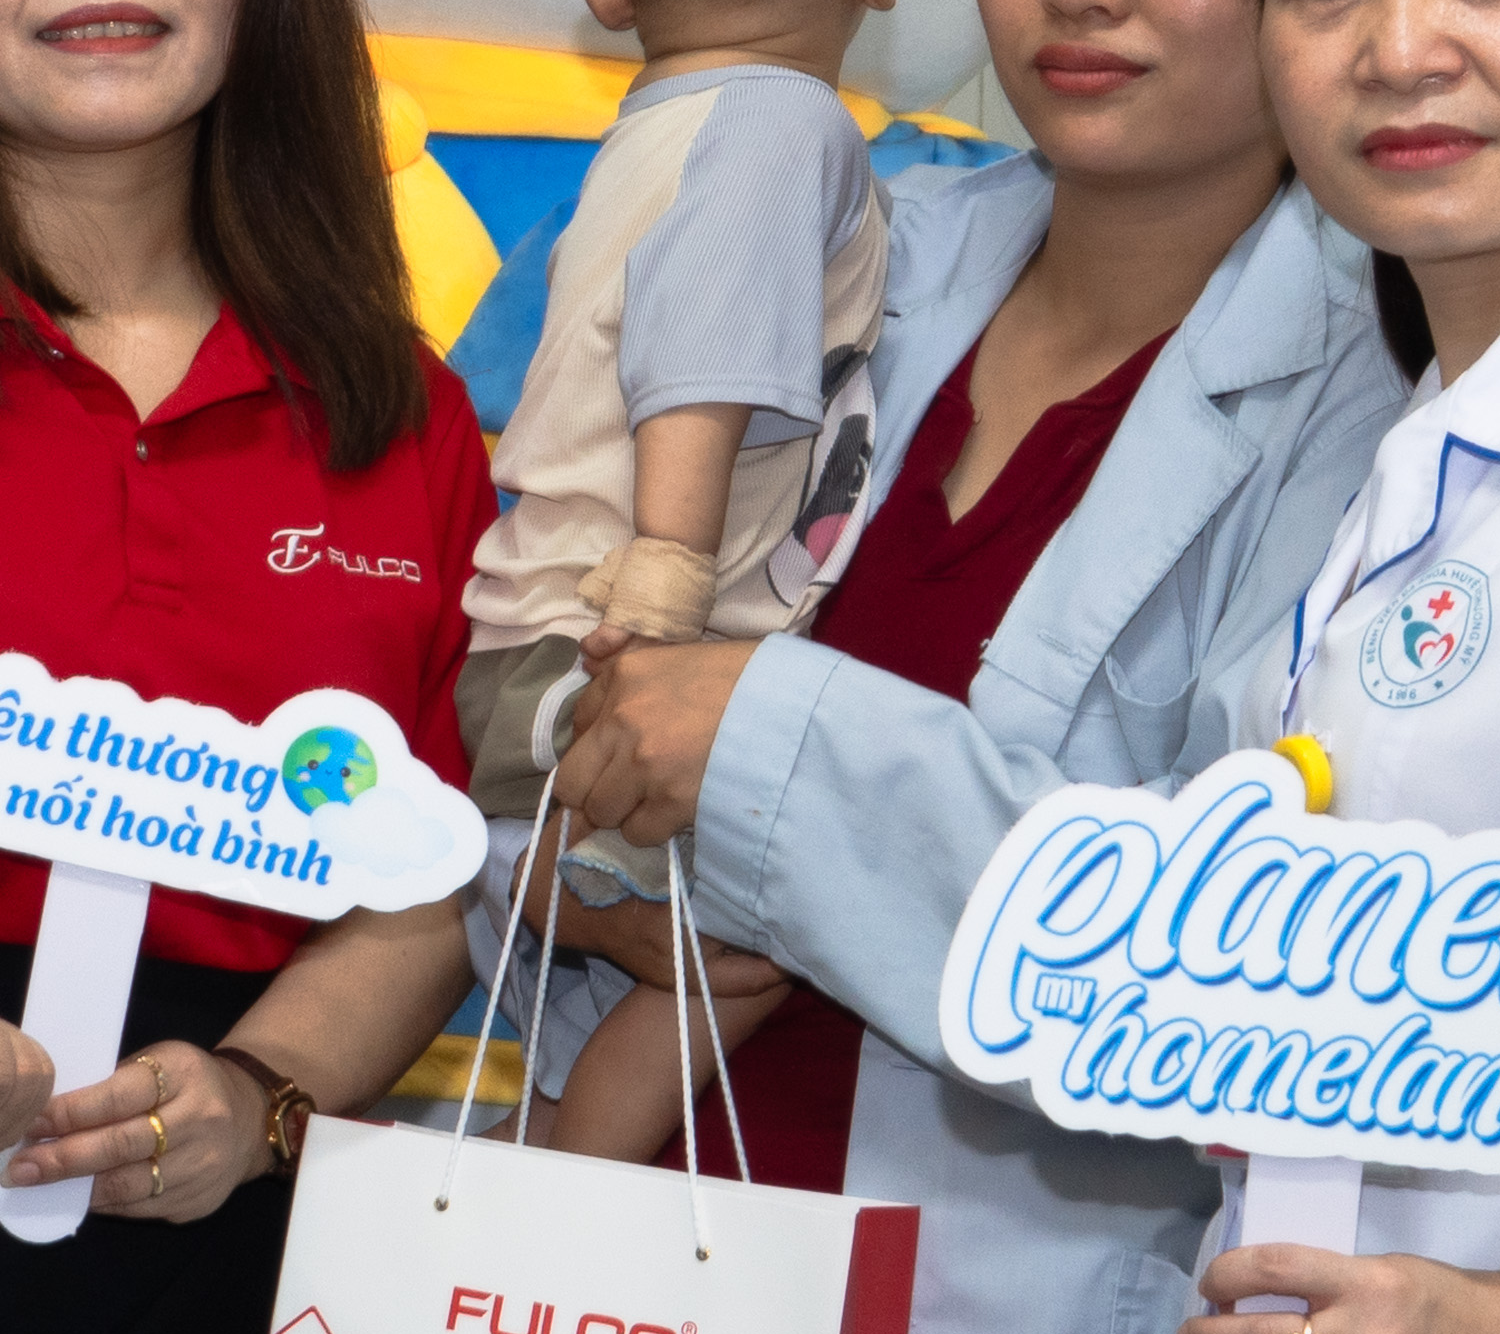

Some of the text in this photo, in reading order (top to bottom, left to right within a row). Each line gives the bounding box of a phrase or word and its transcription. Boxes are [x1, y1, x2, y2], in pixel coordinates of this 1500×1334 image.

[327, 546, 421, 582] FULCO
[67, 714, 279, 811] thương
[6, 776, 96, 831] nối
[101, 794, 204, 856] hoà
[212, 819, 335, 886] bình
[1034, 973, 1095, 1021] my
